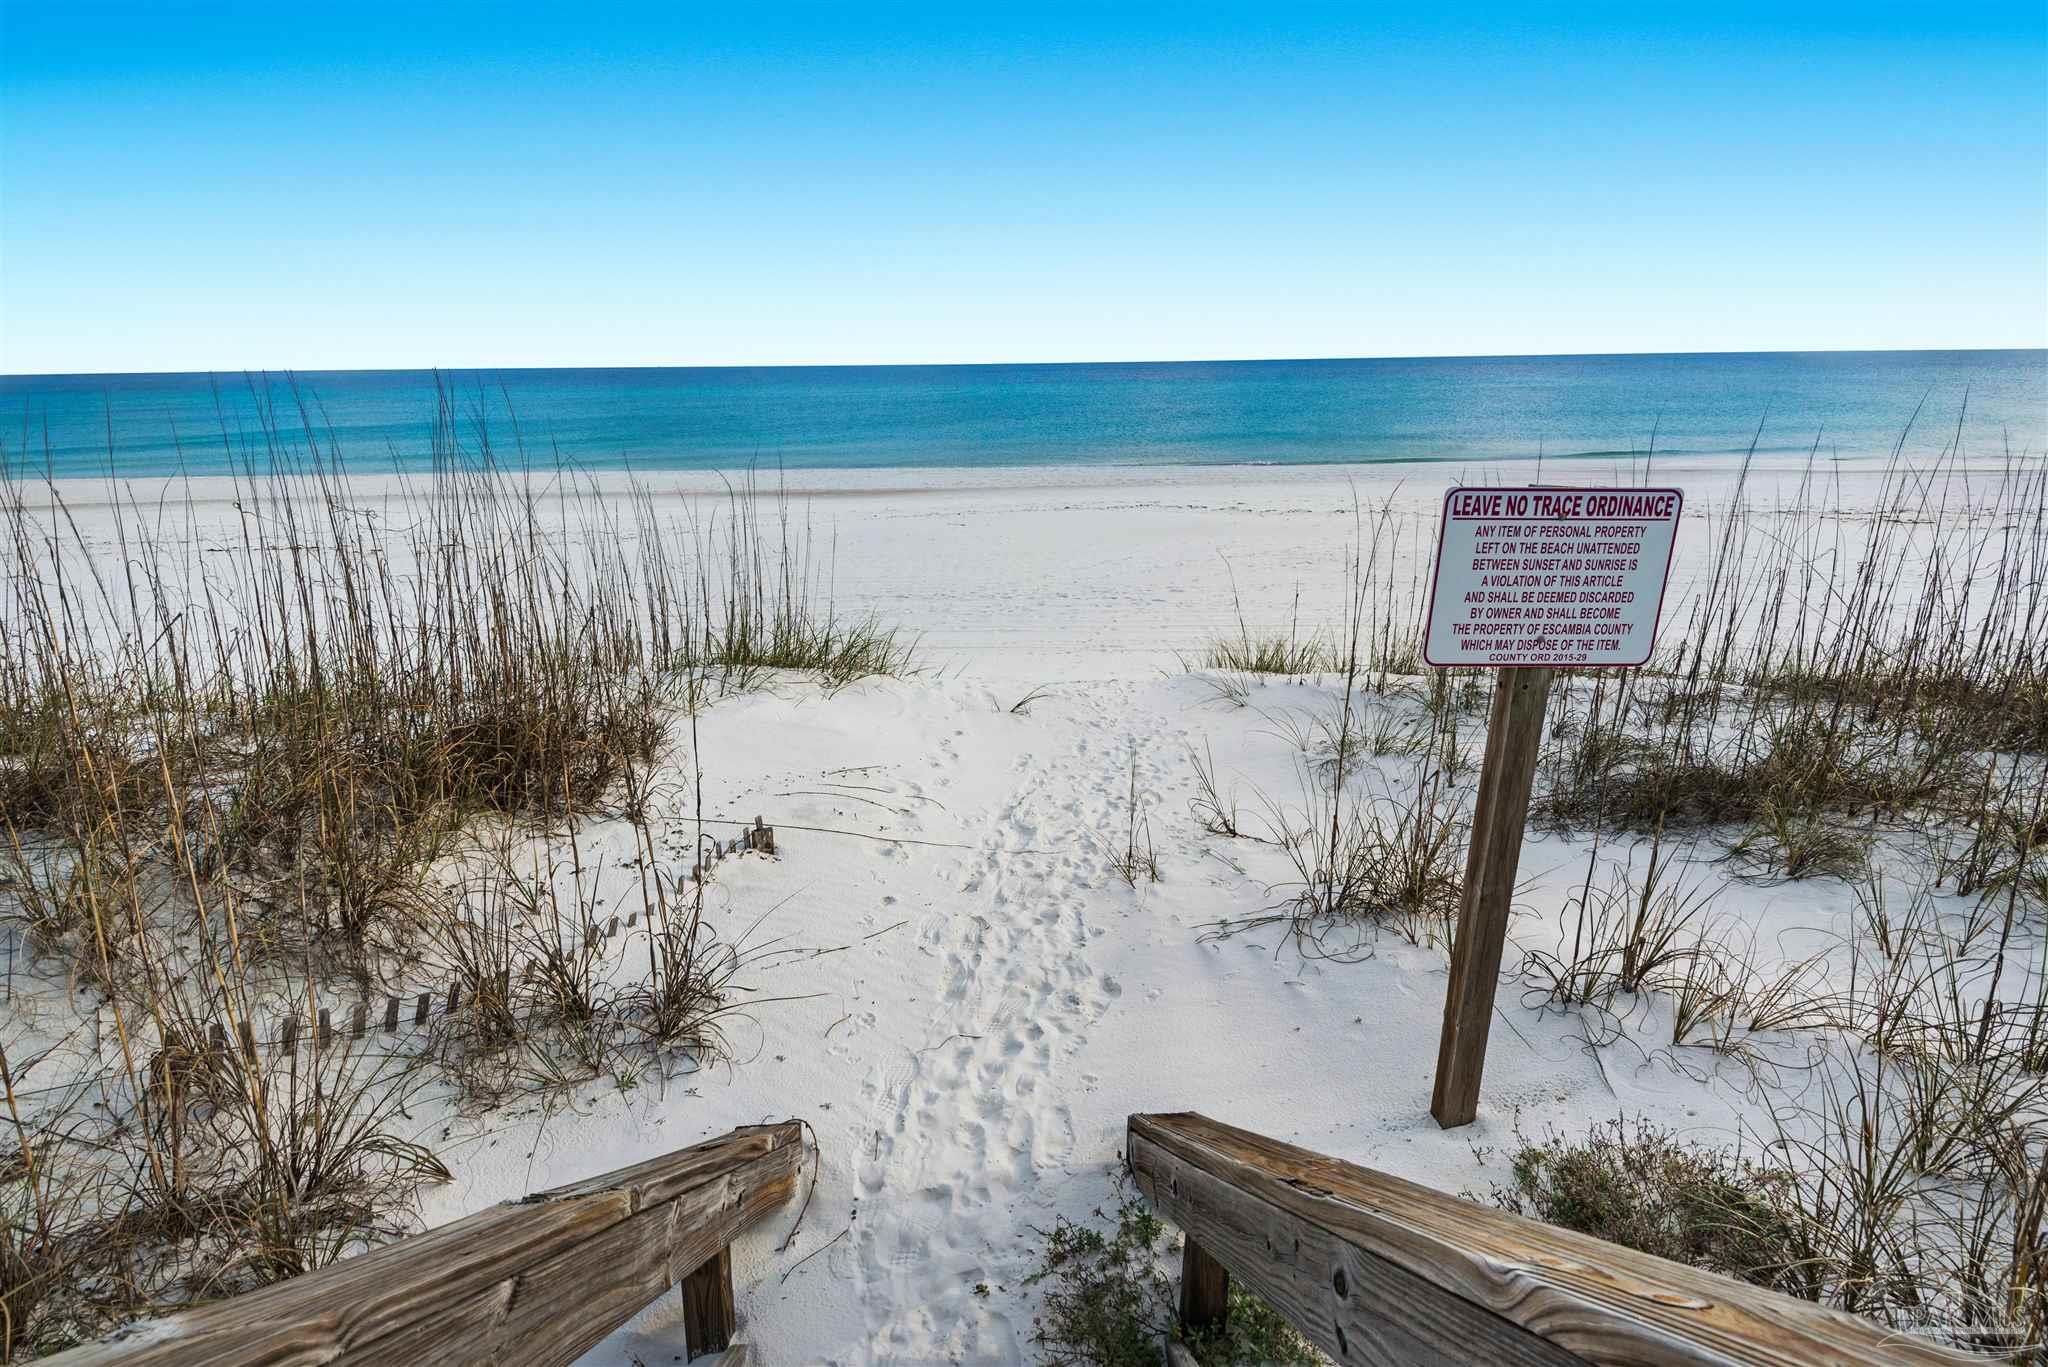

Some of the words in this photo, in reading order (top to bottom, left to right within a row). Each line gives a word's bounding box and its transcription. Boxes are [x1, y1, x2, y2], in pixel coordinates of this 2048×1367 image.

[1453, 495, 1502, 516] LEAVE
[1506, 495, 1527, 516] NO
[1533, 495, 1581, 516] TRACE
[1586, 495, 1674, 516] ORDINANCE
[1476, 526, 1496, 538] ANY
[1498, 526, 1521, 538] ITEM
[1524, 526, 1537, 538] OF
[1539, 526, 1592, 538] PERSONAL
[1595, 526, 1646, 538] PROPERTY
[1476, 543, 1500, 554] LEFT
[1502, 543, 1517, 554] ON
[1520, 543, 1538, 554] THE
[1541, 543, 1574, 554] BEACH
[1577, 543, 1640, 554] UNATTENDED
[1472, 559, 1520, 570] BETWEEN
[1522, 559, 1561, 570] SUNSET
[1562, 559, 1582, 570] AND
[1585, 559, 1627, 570] SUNRISE
[1628, 559, 1638, 570] IS
[1481, 575, 1489, 587] A
[1491, 575, 1541, 587] VIOLATION
[1544, 575, 1558, 587] OF
[1559, 575, 1581, 587] THIS
[1582, 575, 1623, 587] ARTICLE
[1464, 592, 1485, 603] AND
[1487, 592, 1519, 603] SHALL
[1521, 592, 1535, 603] BE
[1537, 592, 1577, 603] DEEMED
[1579, 592, 1634, 603] DISCARDED
[1470, 608, 1484, 619] BY
[1486, 608, 1522, 619] OWNER
[1524, 608, 1544, 619] AND
[1546, 608, 1577, 619] SHALL
[1580, 608, 1620, 619] BECOME
[1453, 624, 1471, 635] THE
[1473, 624, 1525, 635] PROPERTY
[1527, 624, 1540, 635] OF
[1542, 624, 1591, 635] ESCAMBIA
[1594, 624, 1633, 635] COUNTY
[1460, 639, 1493, 651] WHICH
[1495, 639, 1515, 651] MAY
[1517, 639, 1558, 651] DISPOSE
[1561, 639, 1574, 651] OF
[1577, 639, 1594, 651] THE
[1596, 639, 1621, 651] ITEM.
[1489, 653, 1528, 661] COUNTY
[1530, 653, 1550, 661] ORD
[1553, 653, 1587, 661] 2015-29
